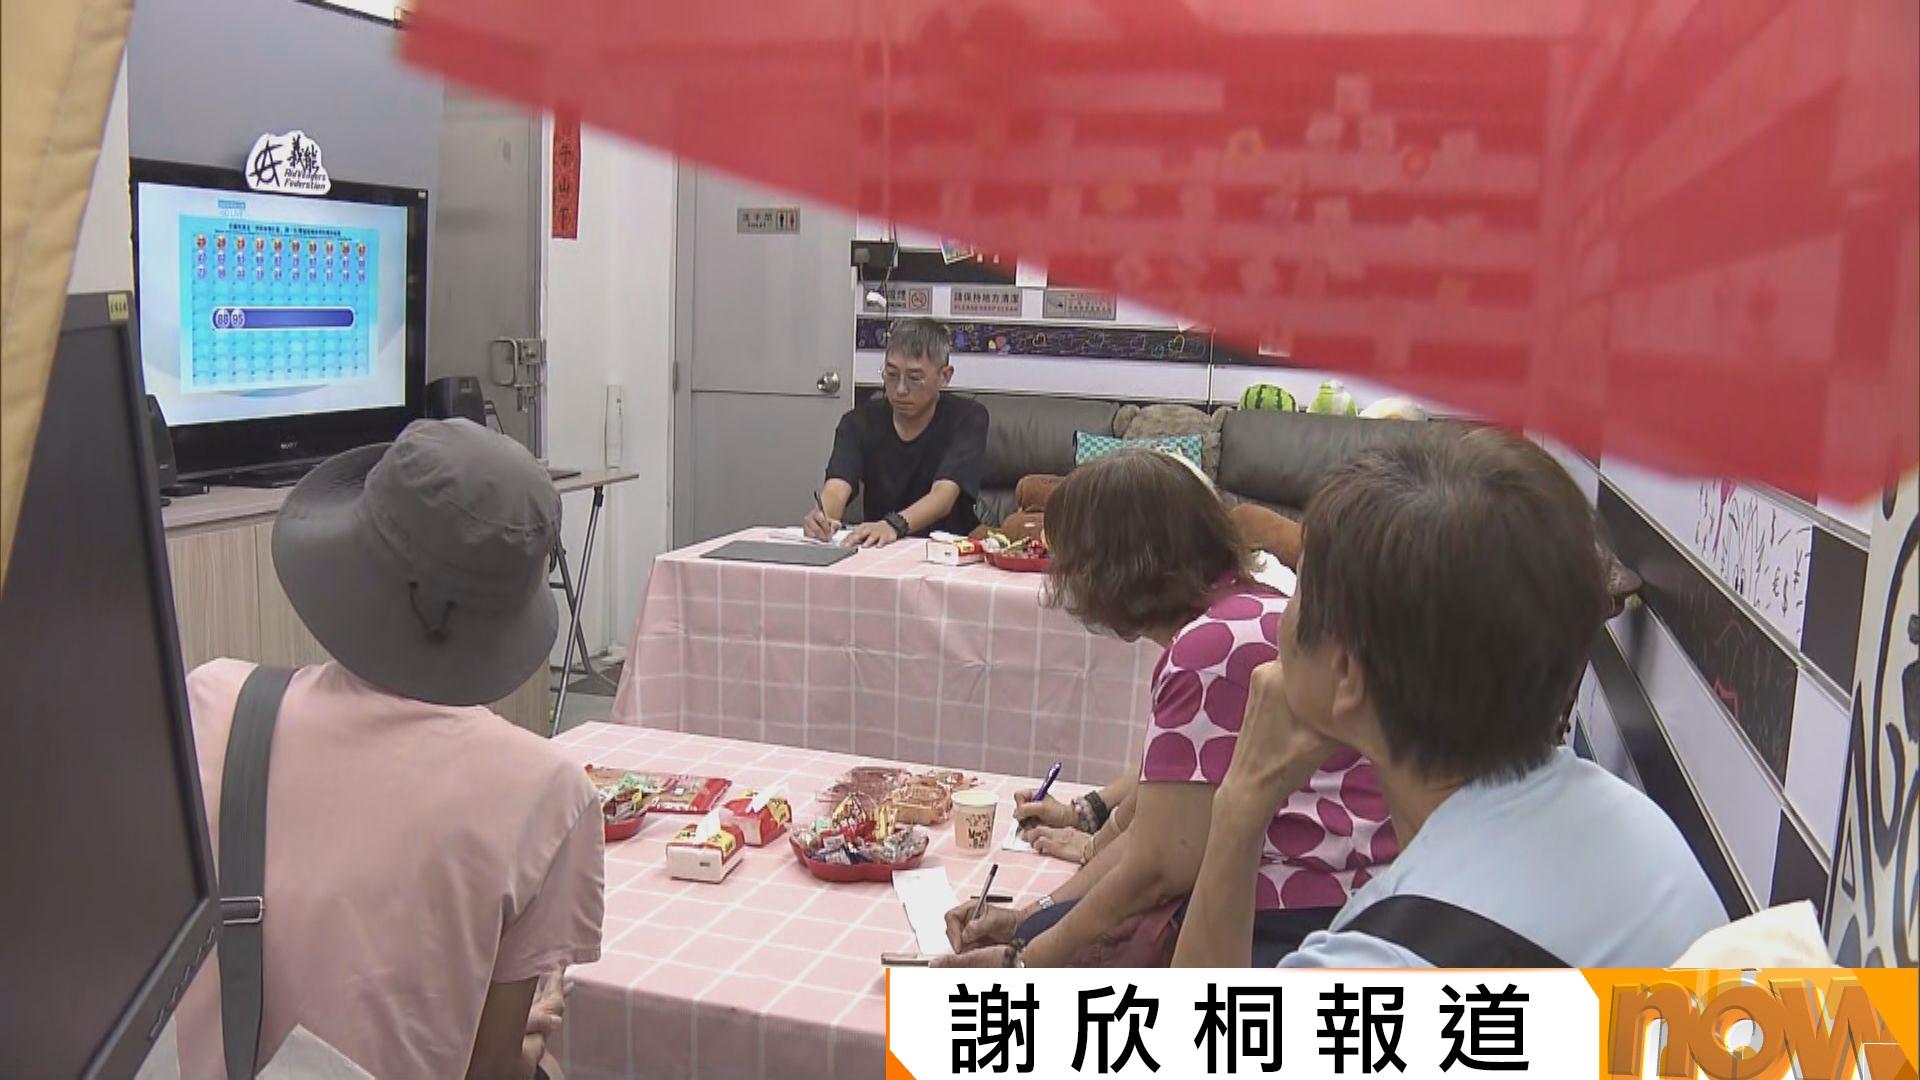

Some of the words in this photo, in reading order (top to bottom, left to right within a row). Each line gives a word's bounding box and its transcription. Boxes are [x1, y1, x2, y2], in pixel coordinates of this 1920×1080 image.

[953, 291, 1019, 304] 請保持地方清潔
